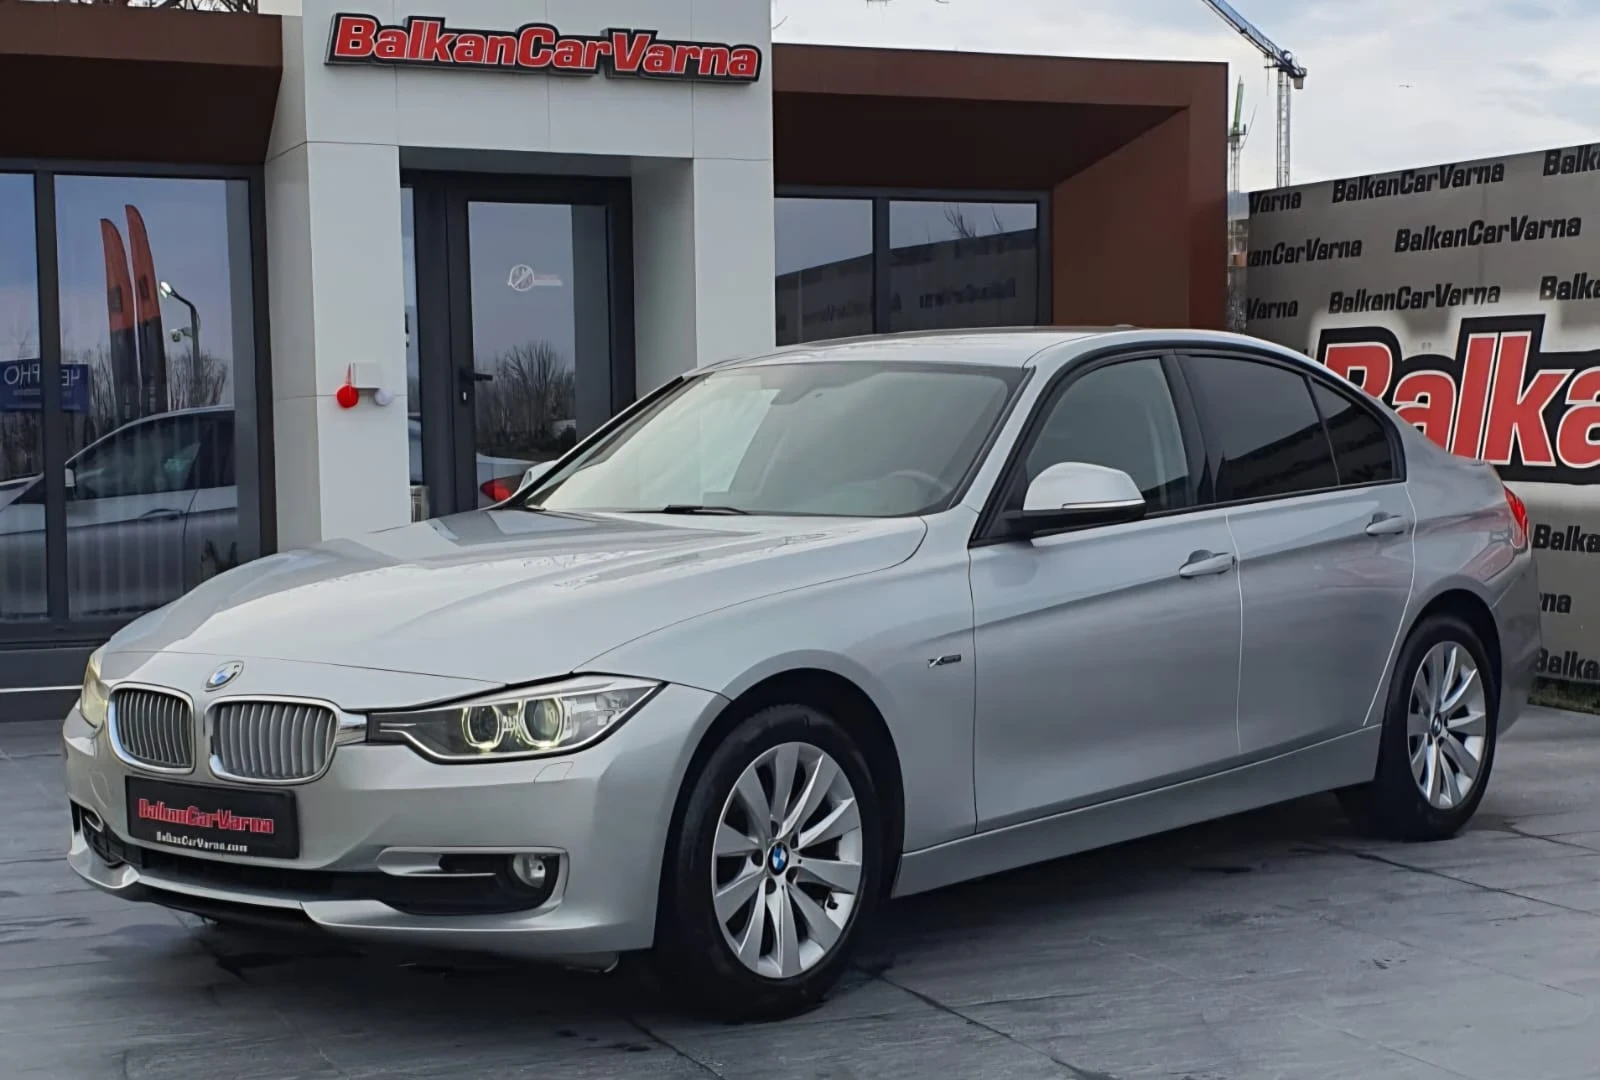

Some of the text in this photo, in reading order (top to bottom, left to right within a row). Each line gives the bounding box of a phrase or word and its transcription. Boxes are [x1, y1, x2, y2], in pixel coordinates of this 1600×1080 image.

[333, 15, 760, 78] BalkanCarVarna
[1543, 144, 1600, 176] Balk
[1332, 162, 1505, 203] BalkanCarVarna
[1248, 190, 1302, 214] Varna
[1395, 215, 1582, 252] BalkanCarVarna
[1247, 297, 1298, 320] Varna
[1329, 283, 1501, 314] BalkanCarVarna
[1540, 592, 1571, 614] na
[138, 798, 275, 834] BalkanCarVarna
[156, 832, 248, 852] BalkanCarVarna.com
